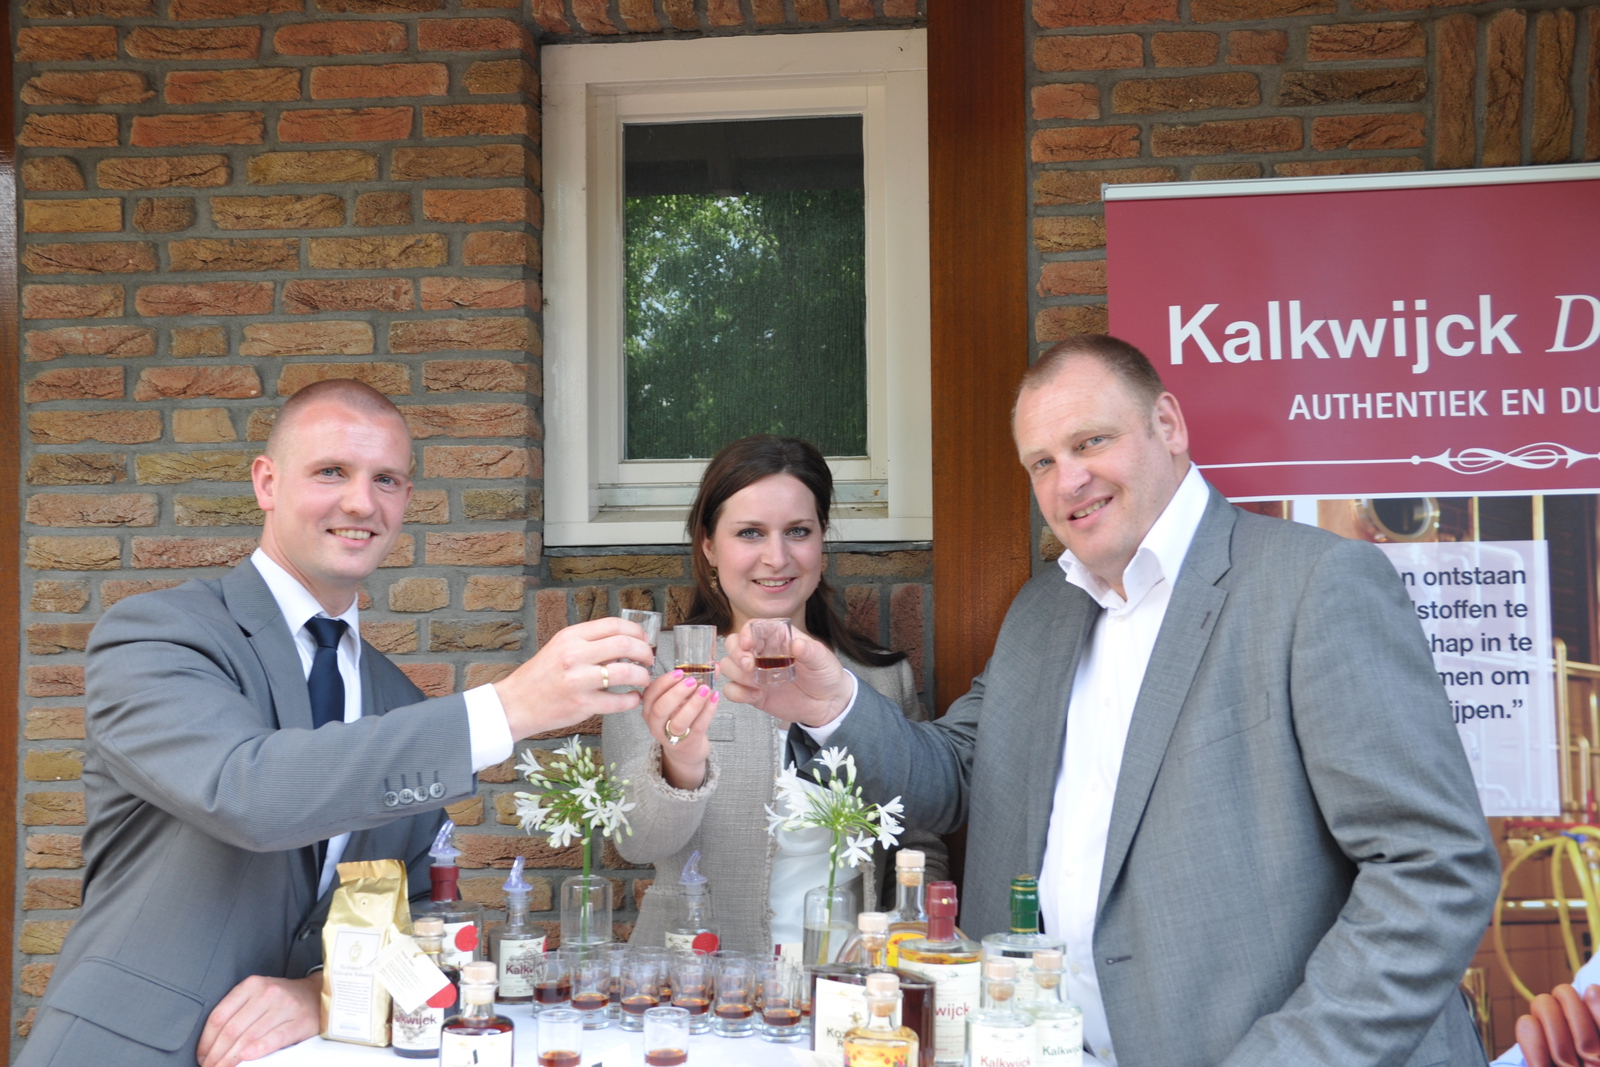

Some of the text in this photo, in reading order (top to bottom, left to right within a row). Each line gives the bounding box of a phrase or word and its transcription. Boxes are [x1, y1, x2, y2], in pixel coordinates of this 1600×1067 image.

[1168, 294, 1522, 374] Kalkwijck
[1288, 390, 1488, 421] AUTHENTIEK
[1501, 388, 1545, 417] EN
[1423, 567, 1526, 586] ontstaan
[1411, 599, 1528, 620] stoffen te
[1481, 633, 1501, 652] in
[1508, 632, 1533, 652] te
[1491, 670, 1530, 685] om
